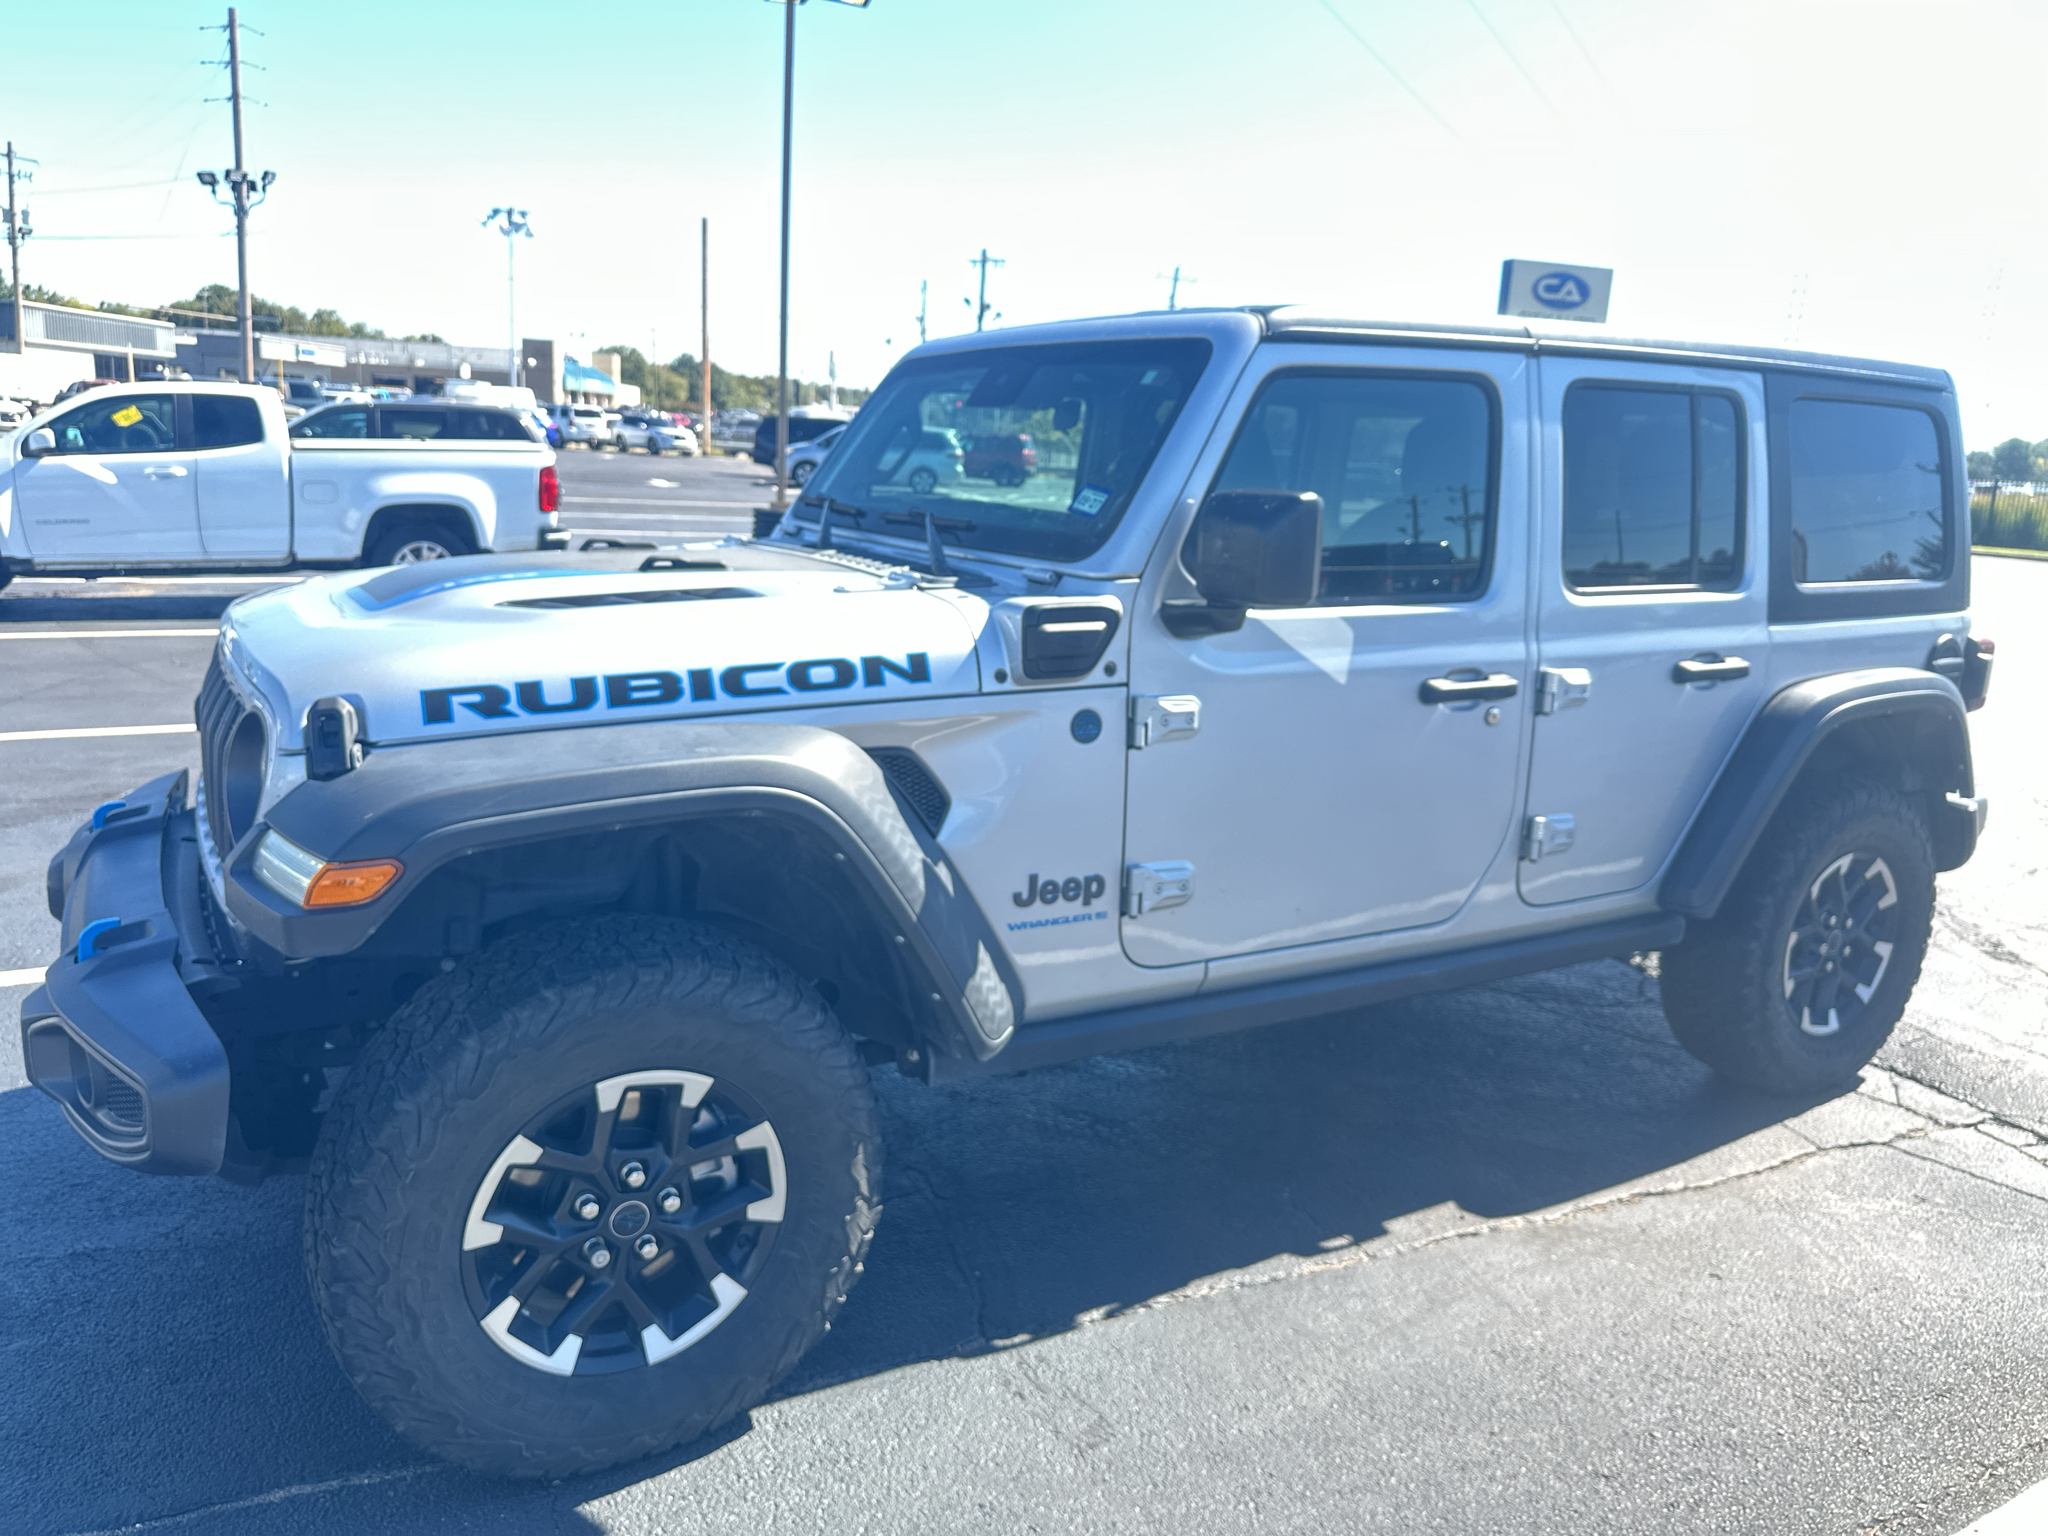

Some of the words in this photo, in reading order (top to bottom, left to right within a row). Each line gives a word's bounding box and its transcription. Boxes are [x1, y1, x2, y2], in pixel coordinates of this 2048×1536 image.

[420, 652, 932, 724] RUBICON
[1013, 873, 1106, 907] Jeep
[1008, 914, 1092, 931] WRANGLER
